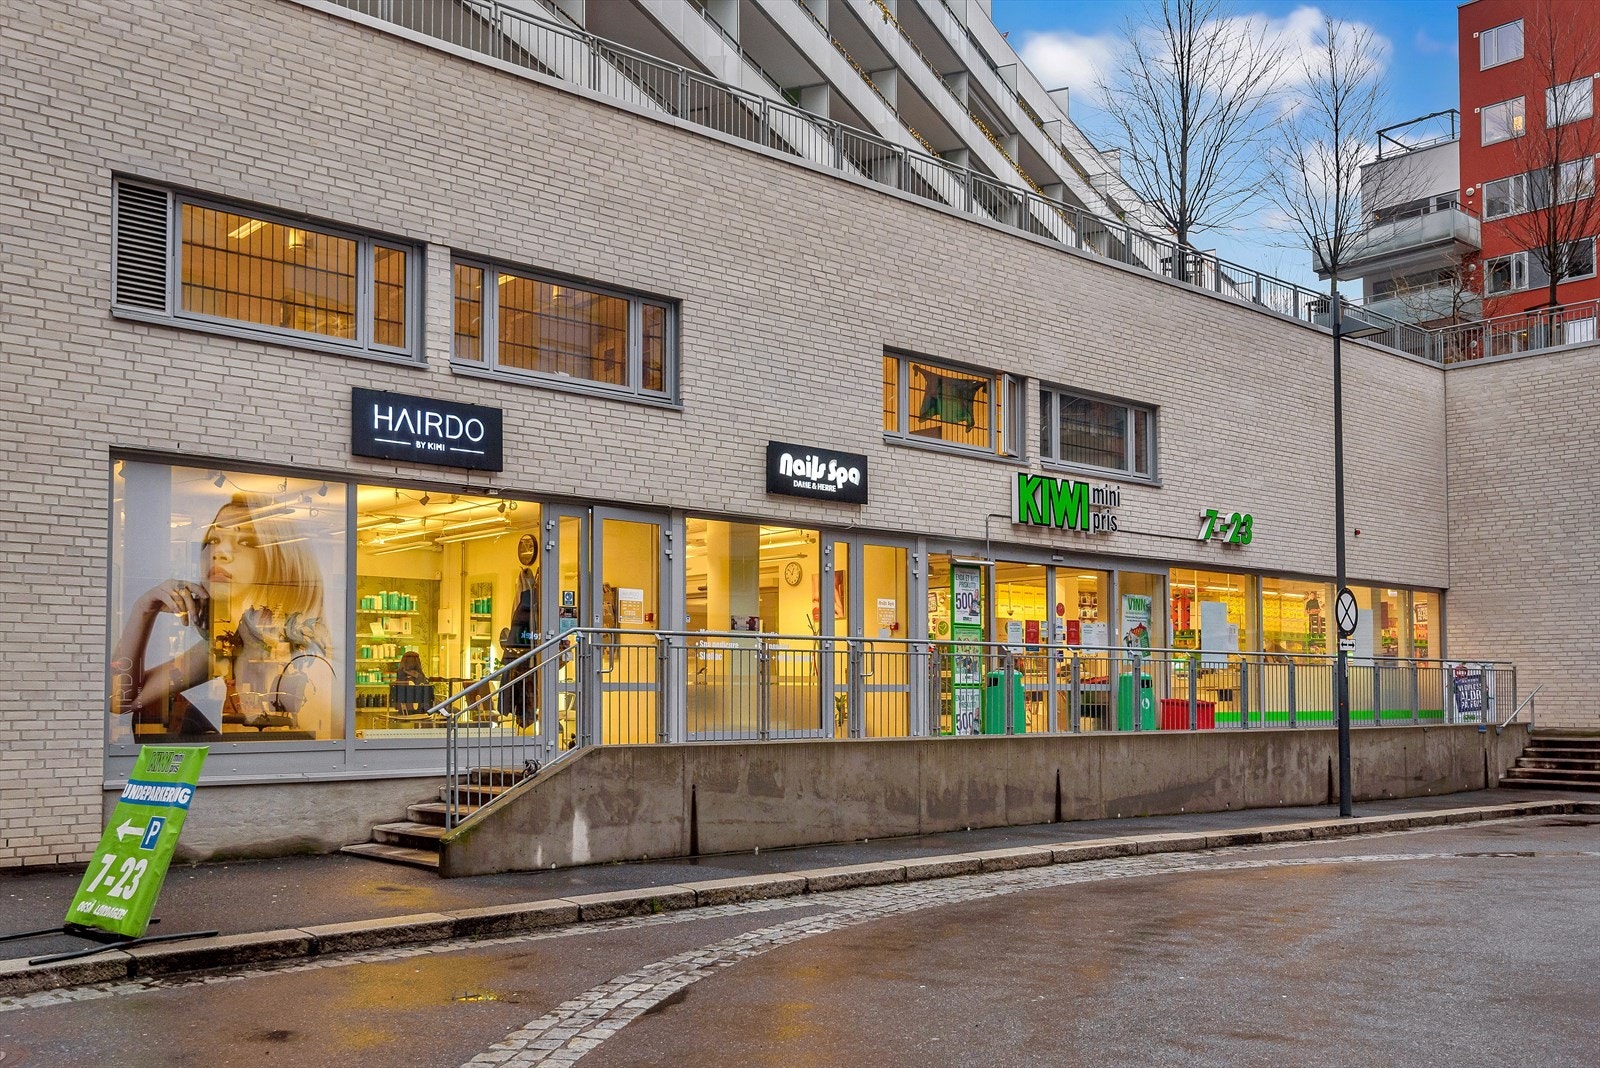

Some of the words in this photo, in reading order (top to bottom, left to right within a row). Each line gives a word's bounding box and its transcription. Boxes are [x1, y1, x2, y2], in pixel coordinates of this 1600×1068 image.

[373, 403, 485, 442] HAIRDO
[415, 440, 426, 449] BY
[427, 441, 446, 451] KIMI
[827, 459, 861, 489] Spa
[793, 480, 811, 489] DAME
[811, 482, 817, 490] &
[817, 483, 837, 493] HERRE
[1016, 471, 1090, 532] KIWI
[1092, 484, 1121, 507] mini
[1092, 510, 1118, 534] pris
[1201, 508, 1254, 546] 7-23
[955, 592, 974, 610] 500
[1127, 597, 1147, 611] VINN
[145, 822, 161, 844] P
[86, 853, 149, 900] 7-23
